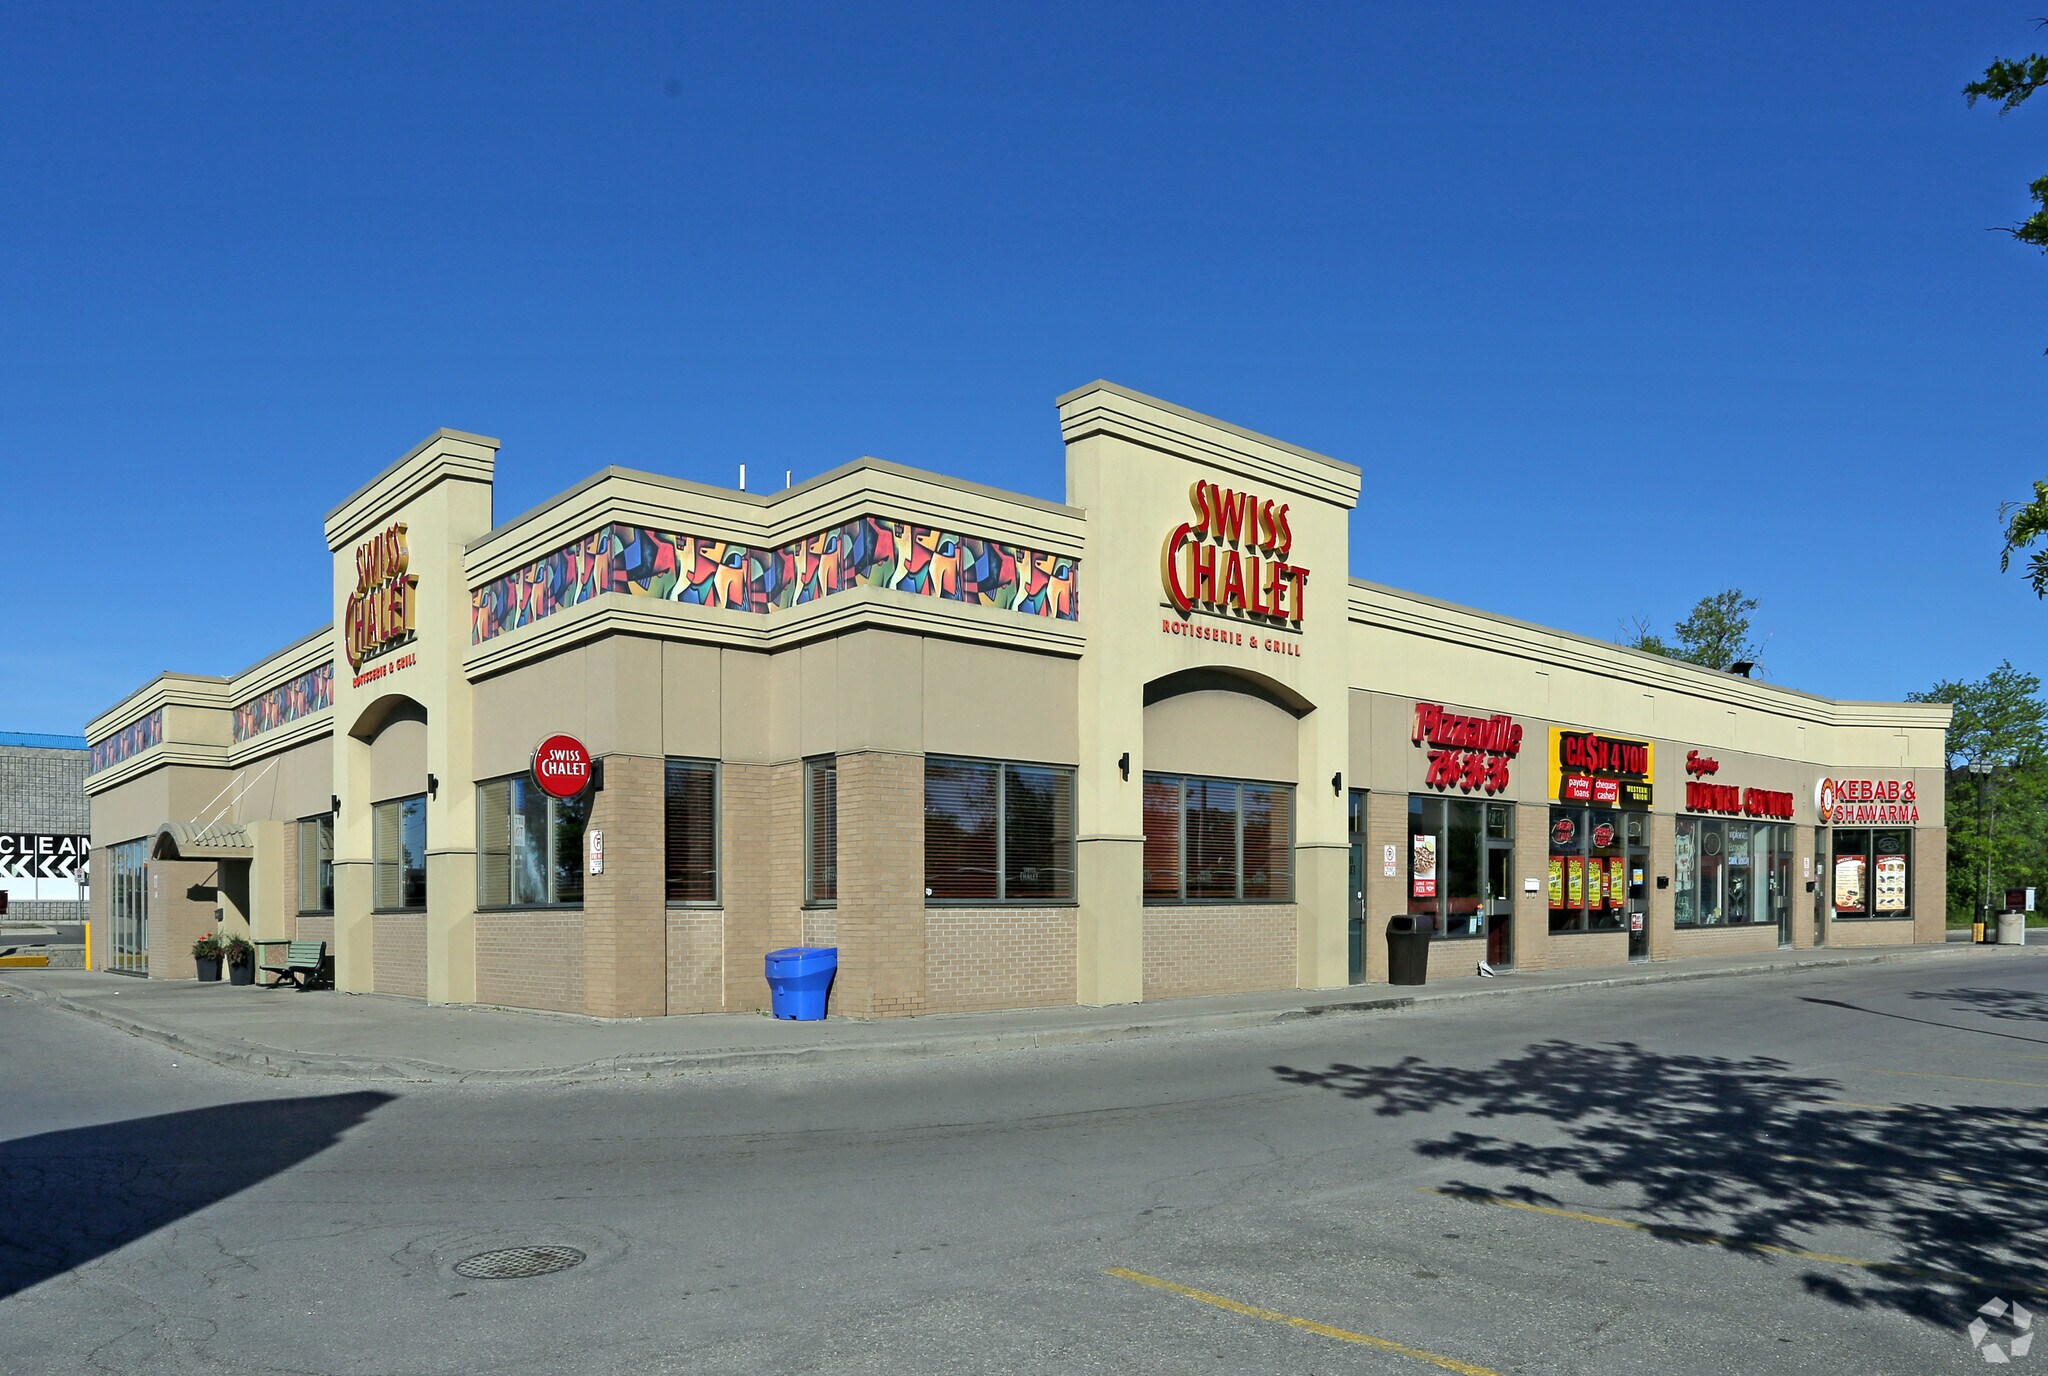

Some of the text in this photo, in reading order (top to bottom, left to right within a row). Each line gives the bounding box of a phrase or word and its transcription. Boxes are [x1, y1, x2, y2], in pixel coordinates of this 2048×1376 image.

[1189, 479, 1292, 554] SWISS
[356, 521, 408, 594] SWISS
[1161, 522, 1310, 621] CHALET
[345, 573, 417, 668] CHALET
[1162, 619, 1301, 657] ROTISSERIE & GRILL
[396, 653, 416, 671] GRILL
[1412, 703, 1523, 754] Pizzaville
[549, 749, 580, 761] SWISS
[1611, 743, 1619, 770] 4
[1622, 744, 1648, 774] YOU
[541, 758, 587, 777] CHALET
[1568, 778, 1589, 789] payday
[1574, 788, 1590, 798] loans
[1595, 780, 1617, 792] cheques
[1626, 785, 1648, 794] WESTERN
[1835, 780, 1900, 800] KEBAB
[1903, 780, 1916, 801] &
[1597, 791, 1616, 800] cashed
[1633, 792, 1648, 800] UNION
[1686, 781, 1743, 813] DENTAL
[1835, 805, 1920, 821] SHAWARMA
